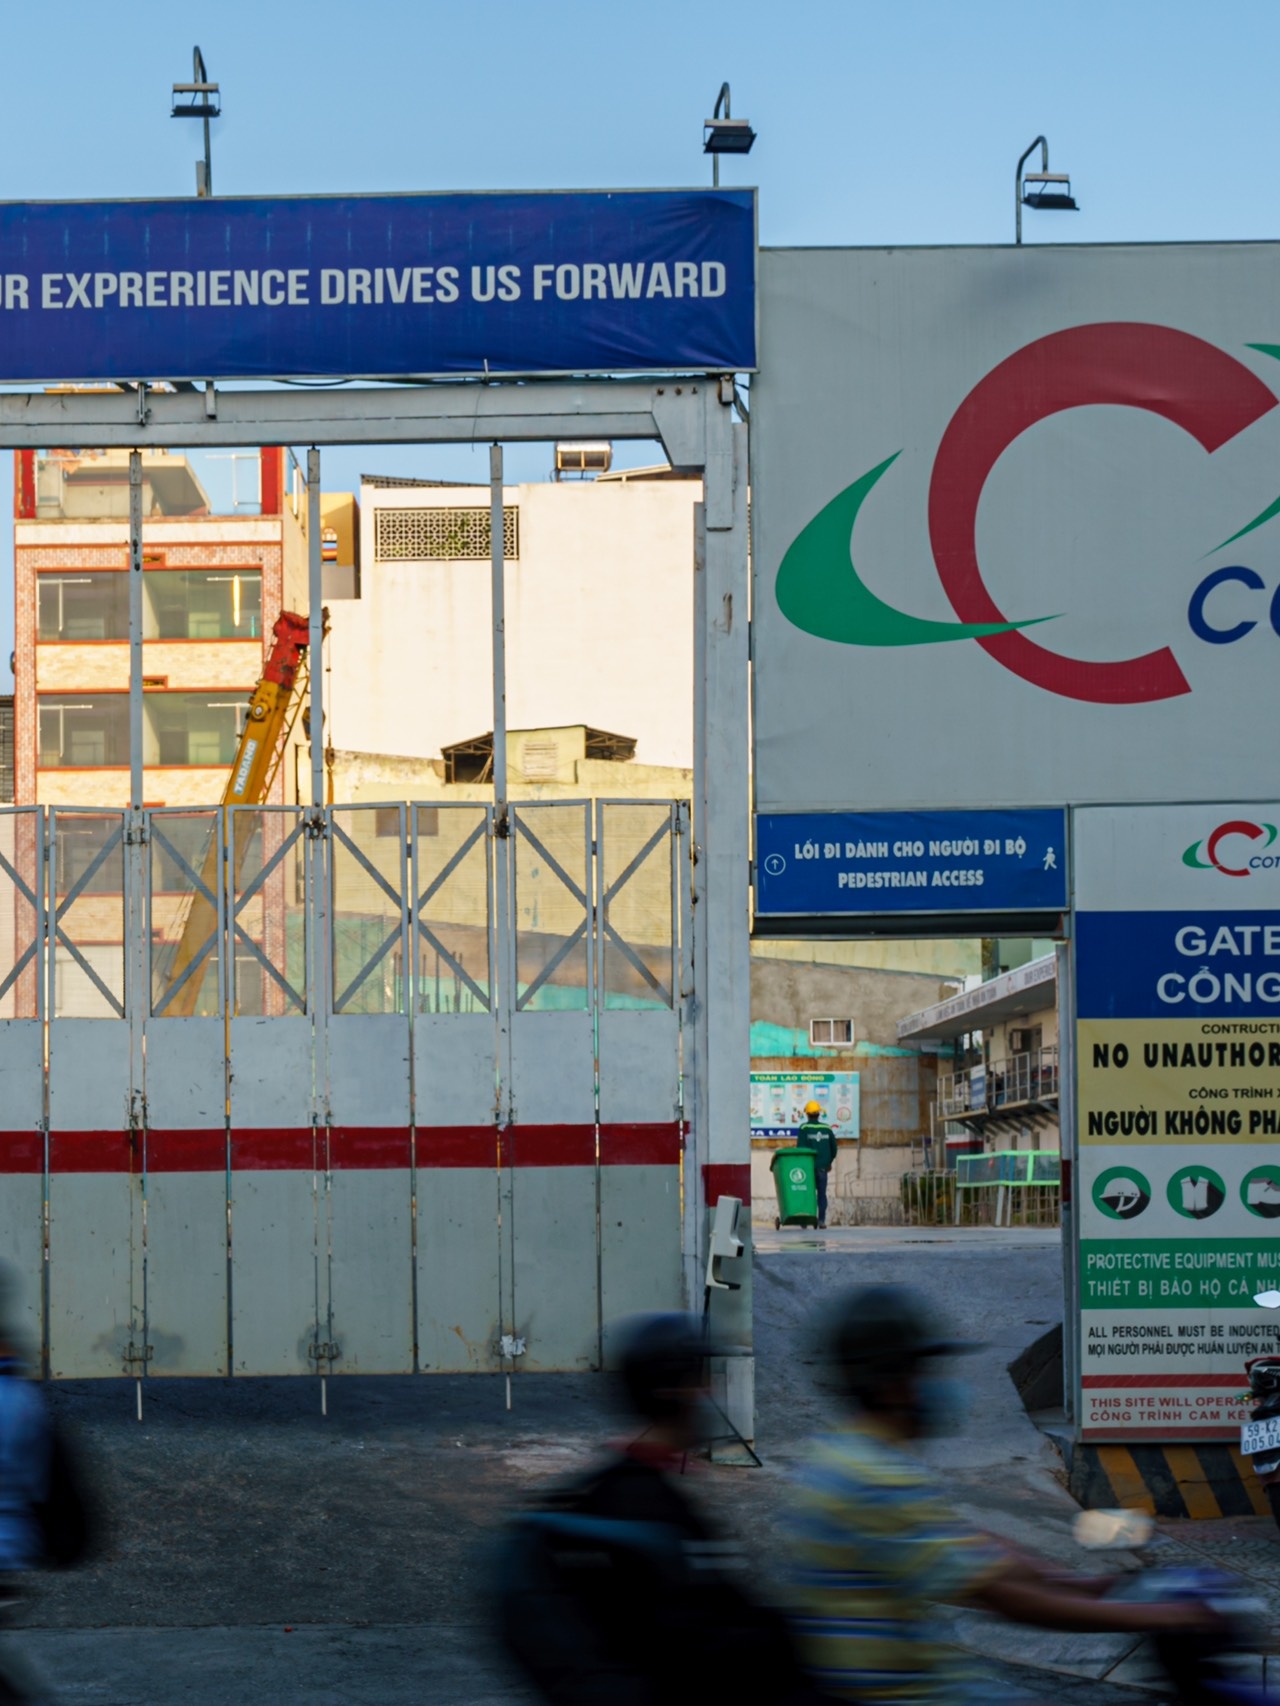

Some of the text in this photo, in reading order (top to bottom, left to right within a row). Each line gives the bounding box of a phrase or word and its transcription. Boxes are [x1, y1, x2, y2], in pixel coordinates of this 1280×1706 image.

[41, 269, 310, 309] EXPRERIENCE
[320, 266, 459, 305] DRIVES
[471, 265, 521, 302] US
[533, 261, 727, 300] FORWARD
[234, 738, 258, 795] TADANO
[794, 835, 1027, 860] LỐI ĐI DÀNH CHO NGƯỜI ĐI BỘ
[838, 870, 984, 888] PEDESTRIAN ACCESS
[1174, 925, 1280, 956] GATE
[1156, 965, 1280, 1004] CỔNG
[1093, 1041, 1280, 1068] NO UNAUTHOR
[1188, 1086, 1229, 1099] CÔNG
[1232, 1086, 1273, 1099] TRÌNH
[1088, 1104, 1280, 1136] NGƯỜI KHÔNG PH
[1087, 1253, 1171, 1269] PROTECTIVE
[1175, 1252, 1253, 1269] EQUIPMENT
[1138, 1280, 1153, 1300] BỊ
[1088, 1326, 1108, 1338] ALL
[1112, 1325, 1173, 1338] PERSONNEL
[1178, 1325, 1205, 1337] MUST
[1210, 1325, 1224, 1337] BE
[1088, 1343, 1106, 1358] MỌI
[1108, 1341, 1140, 1355] NGƯỜI
[1142, 1341, 1164, 1355] PHẢI
[1166, 1342, 1195, 1357] ĐƯỢC
[1227, 1341, 1258, 1357] LUYỆN
[1260, 1342, 1273, 1354] AN
[1090, 1397, 1121, 1408] THIS
[1125, 1397, 1155, 1408] SITE
[1159, 1396, 1192, 1407] WILL
[1090, 1409, 1132, 1421] CÔNG
[1138, 1409, 1182, 1420] TRÌNH
[1189, 1410, 1220, 1420] CAM
[1247, 1419, 1278, 1438] 59-K2
